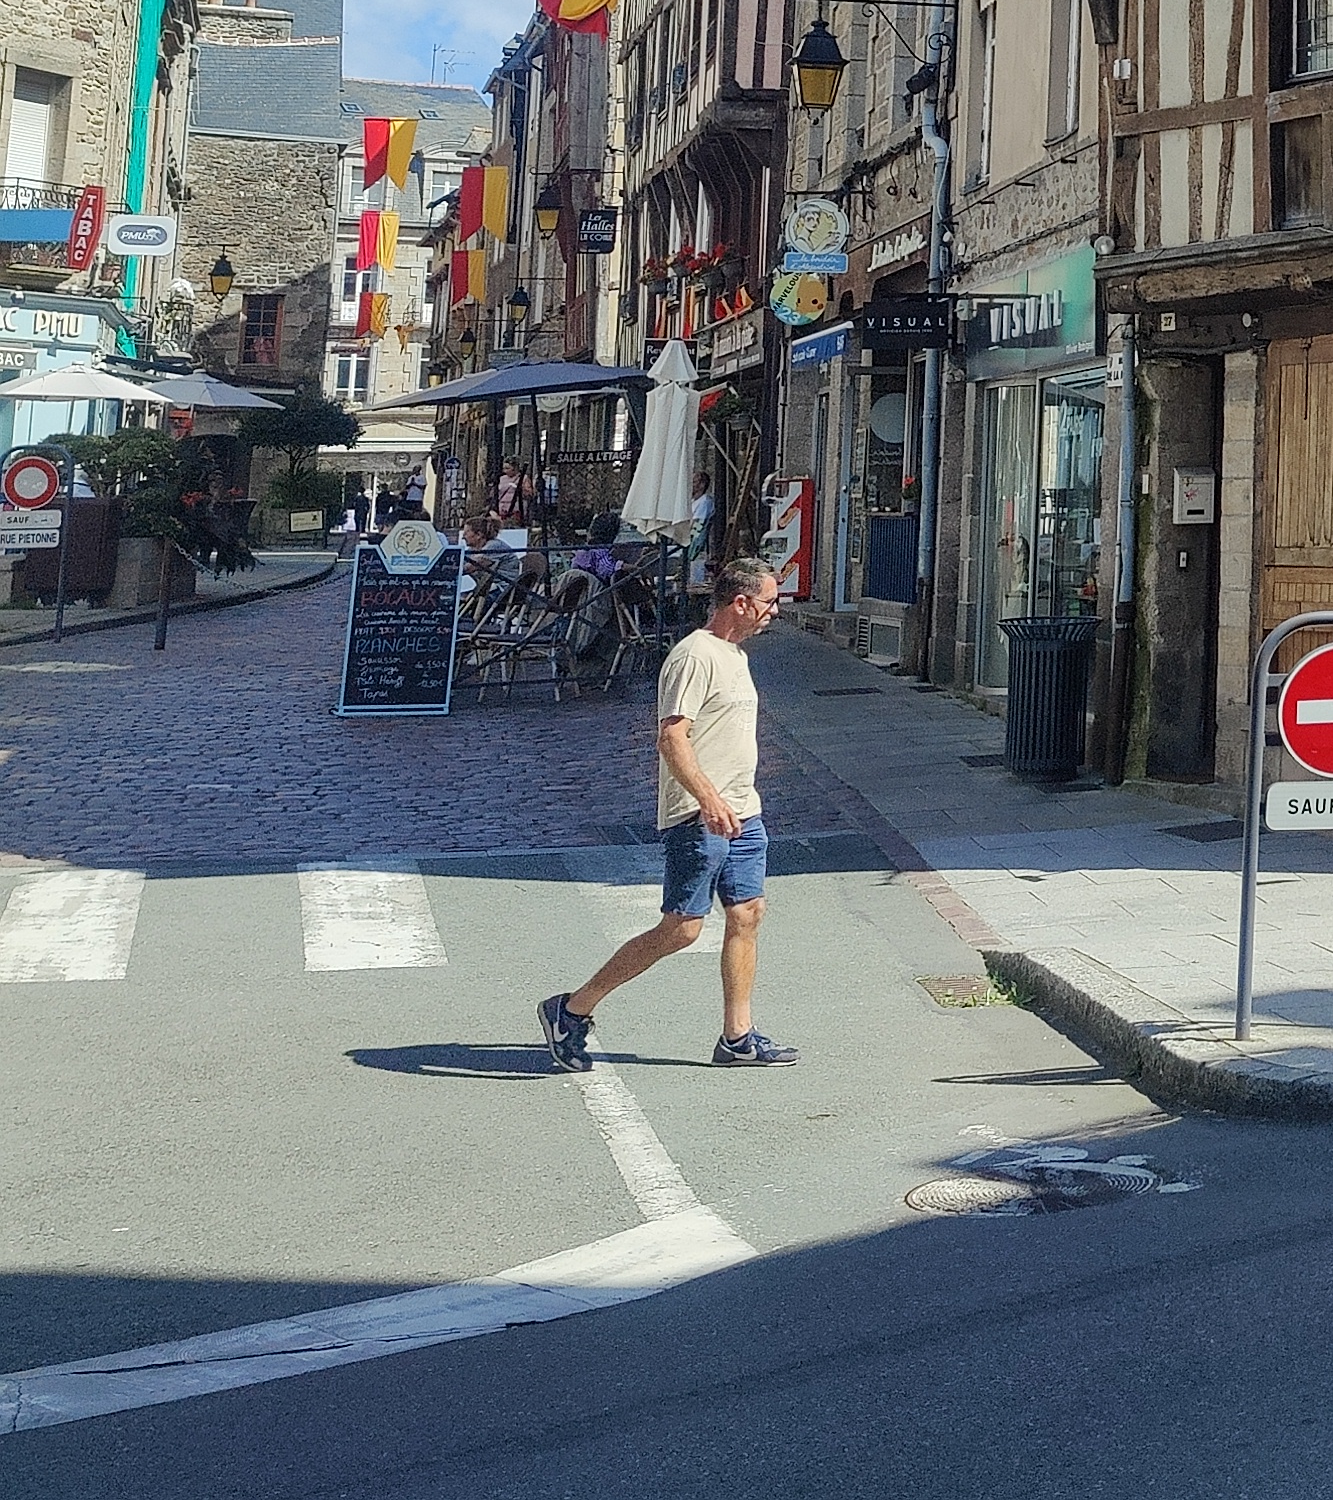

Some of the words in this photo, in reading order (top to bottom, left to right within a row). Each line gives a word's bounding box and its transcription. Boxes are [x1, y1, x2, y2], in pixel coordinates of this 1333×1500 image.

[73, 193, 98, 262] TABAC
[581, 220, 614, 231] Halles
[120, 231, 146, 240] PMU
[772, 272, 802, 312] MARVELOUS
[780, 306, 801, 323] 23
[990, 289, 1062, 343] VISUAL
[1163, 316, 1172, 326] 27
[35, 309, 84, 337] PMU
[867, 317, 945, 328] VISUAL
[557, 453, 585, 463] SALLE
[586, 452, 594, 462] A
[596, 450, 633, 461] L'ETAGE
[6, 516, 30, 524] SAUF
[1, 534, 15, 544] RUE
[19, 532, 57, 544] PIETONNE
[361, 589, 438, 607] BOCAUX
[355, 636, 441, 654] PLANCHES
